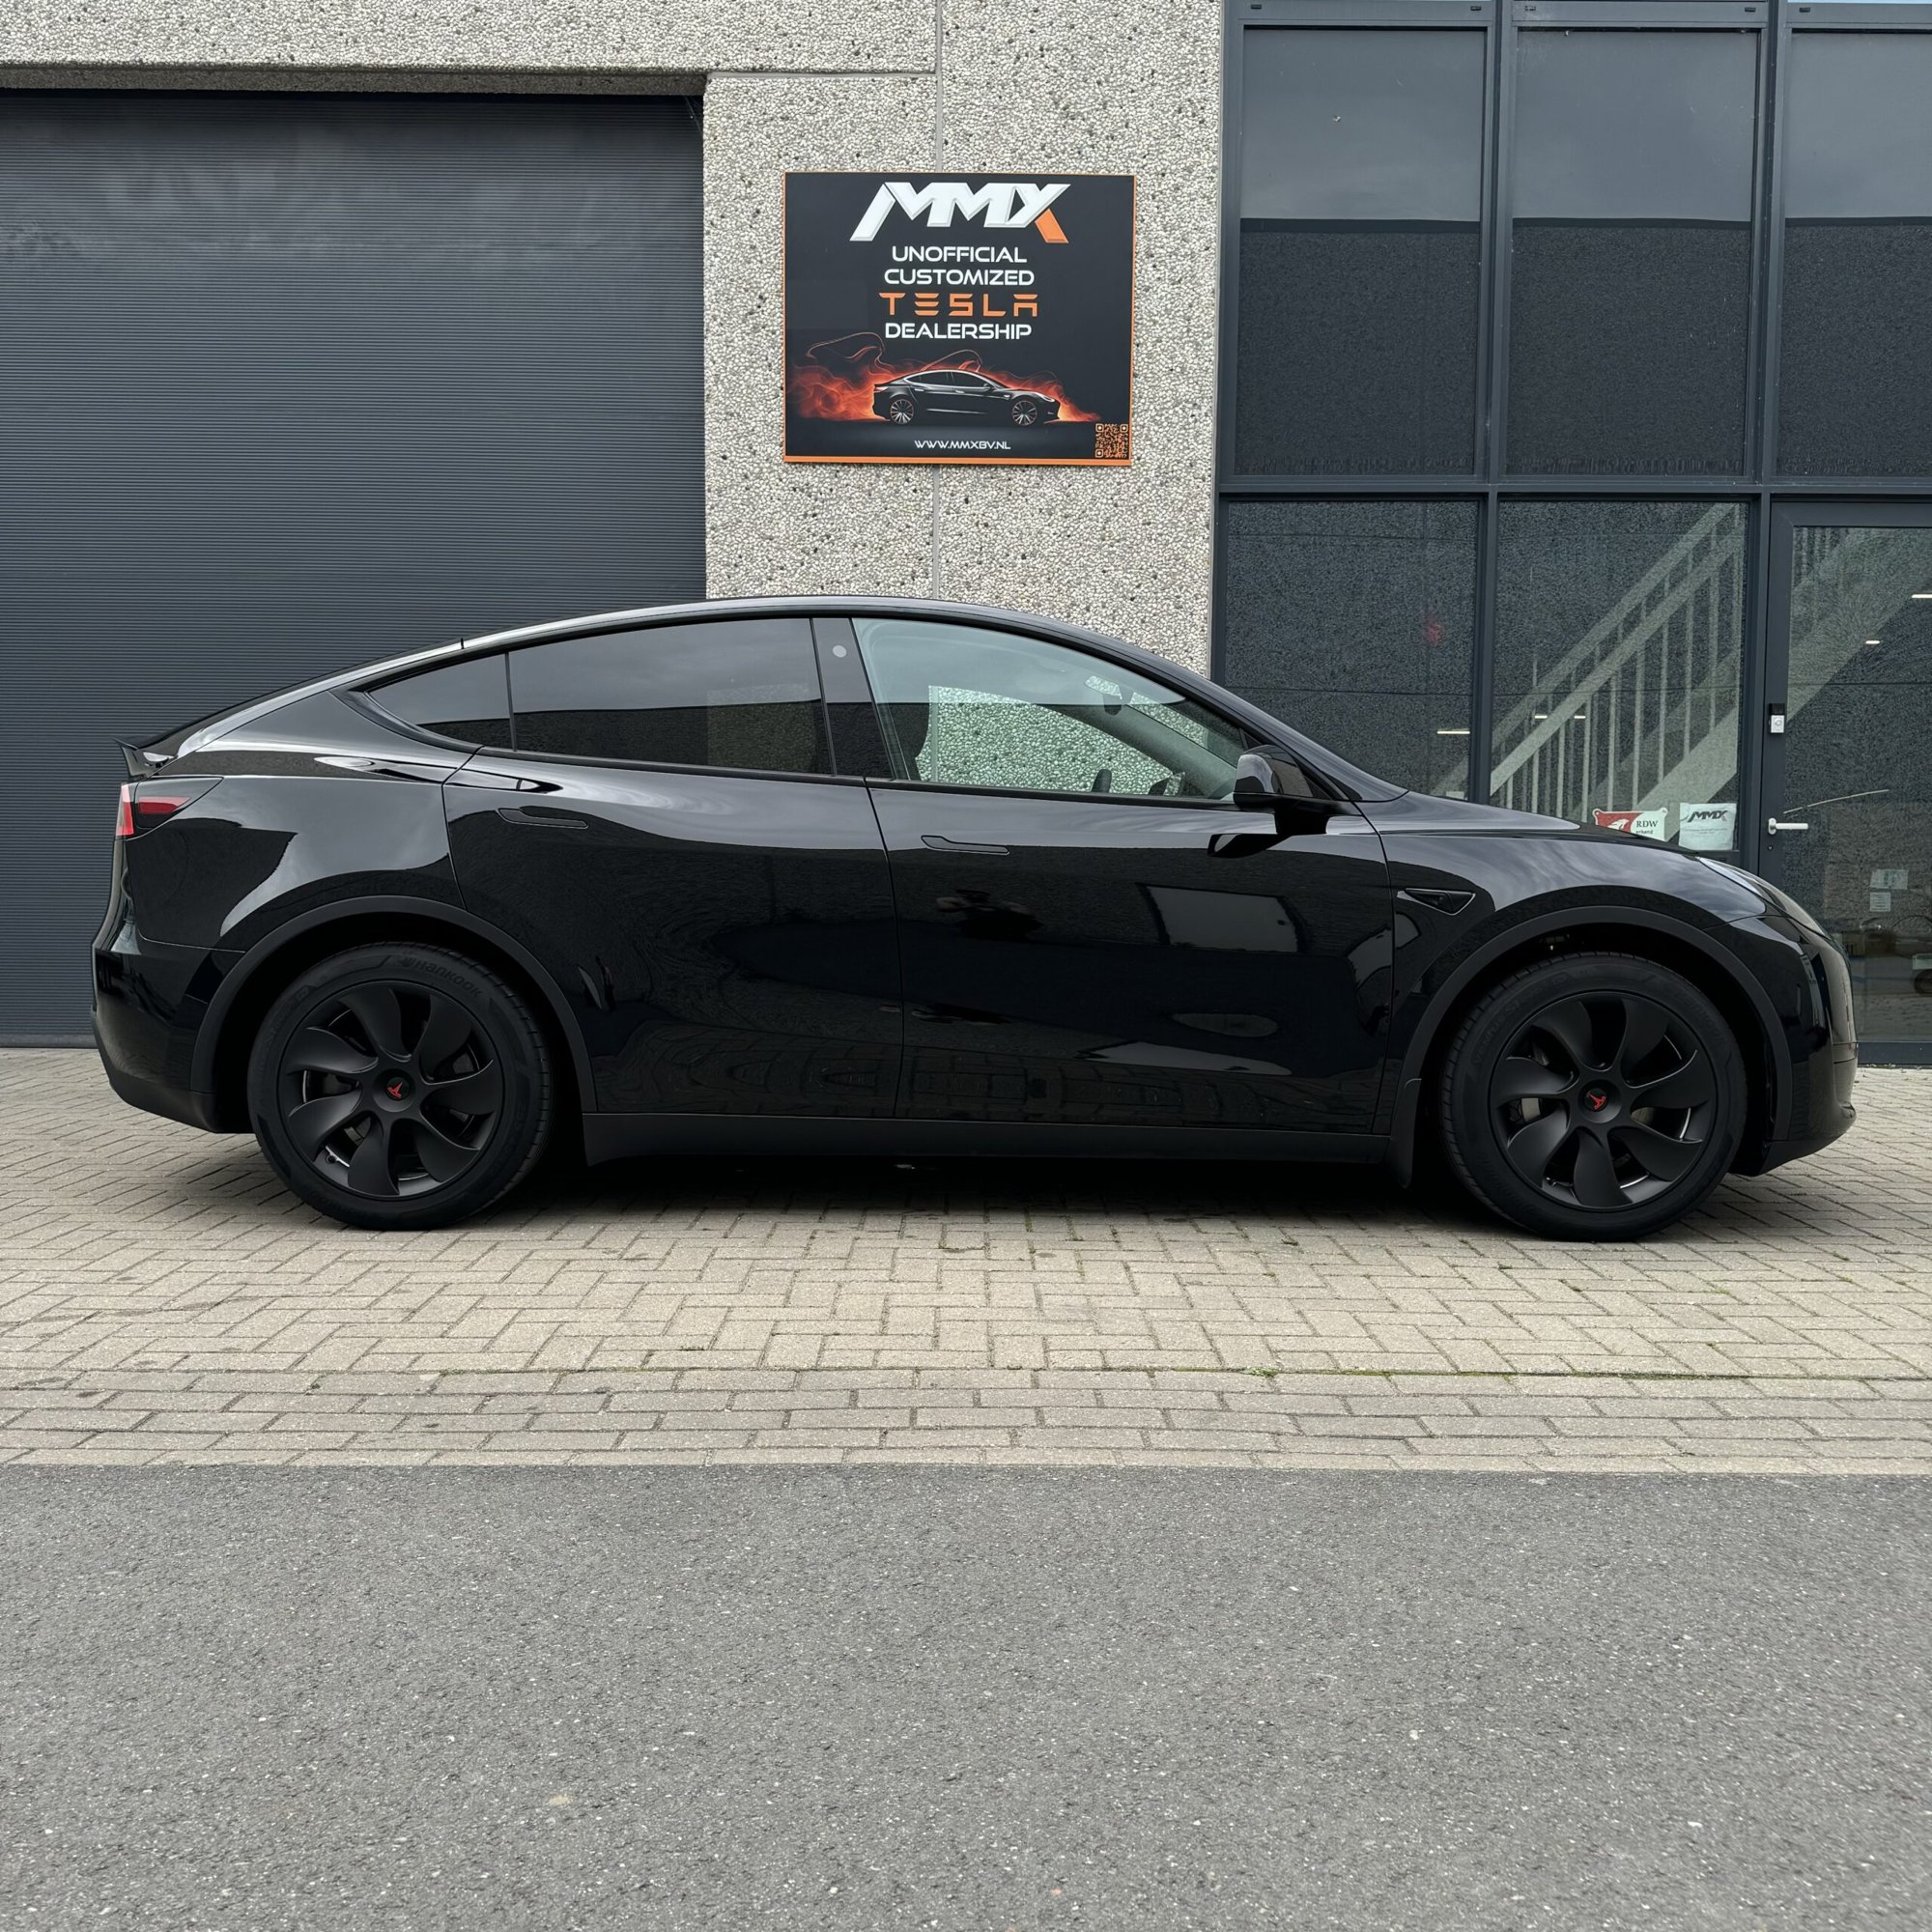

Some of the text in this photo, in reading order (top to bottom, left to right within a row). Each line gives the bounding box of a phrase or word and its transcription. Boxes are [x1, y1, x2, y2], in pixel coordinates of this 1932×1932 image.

[849, 182, 1071, 243] MMX
[892, 245, 1028, 263] UNOFFICIAL
[884, 269, 1035, 286] CUSTOMIZED
[878, 293, 1038, 317] TESLA
[885, 323, 1033, 340] DEALERSHIP
[914, 440, 1011, 450] WWW.MMXBV.NL
[1687, 810, 1728, 823] MMX
